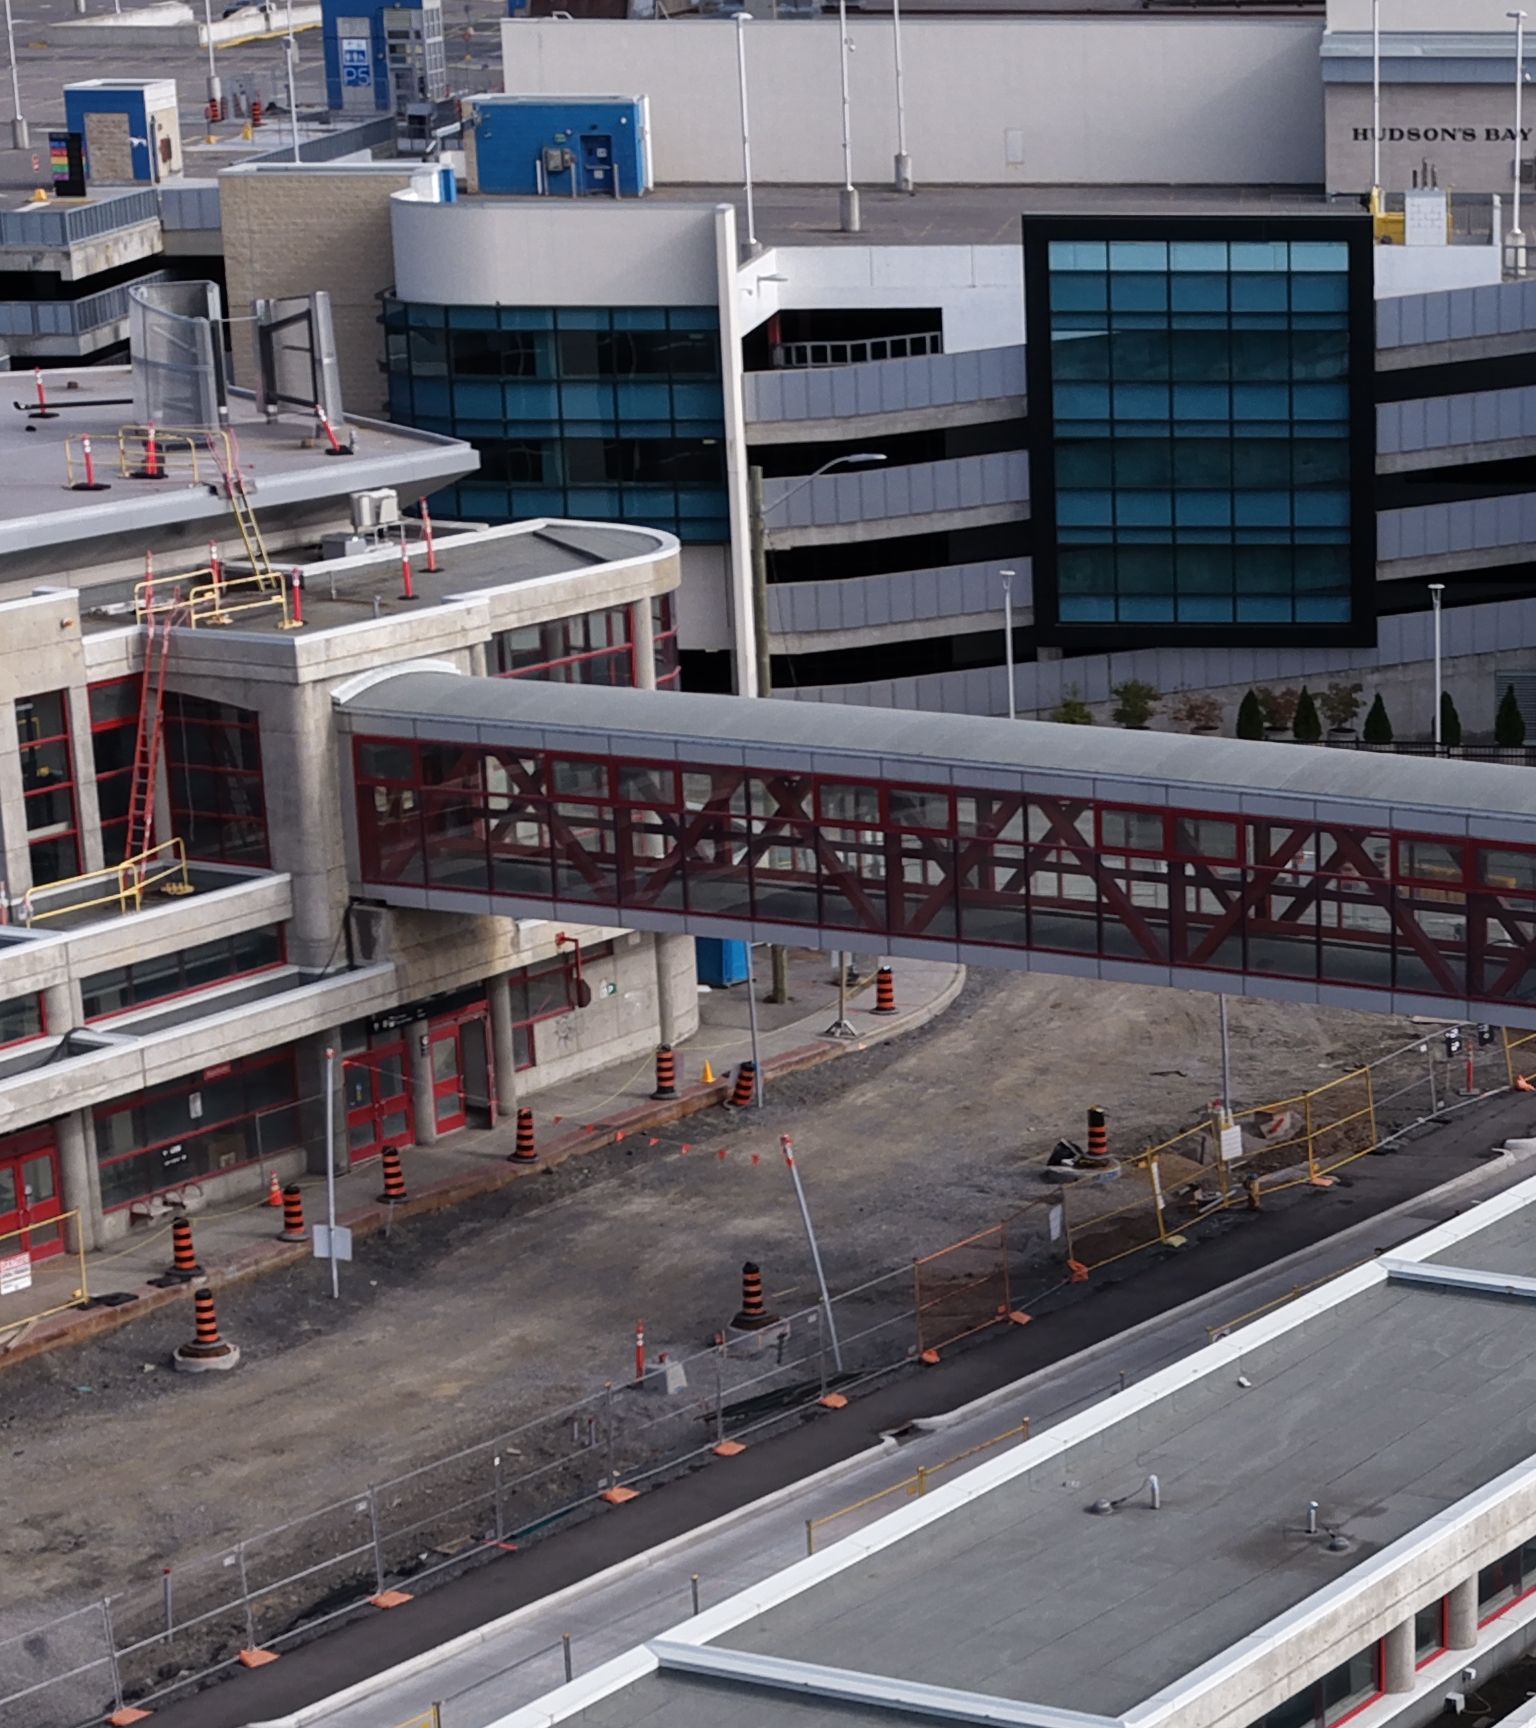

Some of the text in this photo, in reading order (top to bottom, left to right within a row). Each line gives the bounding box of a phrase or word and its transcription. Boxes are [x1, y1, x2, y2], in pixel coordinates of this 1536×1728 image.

[343, 67, 371, 86] P5
[1352, 127, 1533, 142] HUDSON'S BAY
